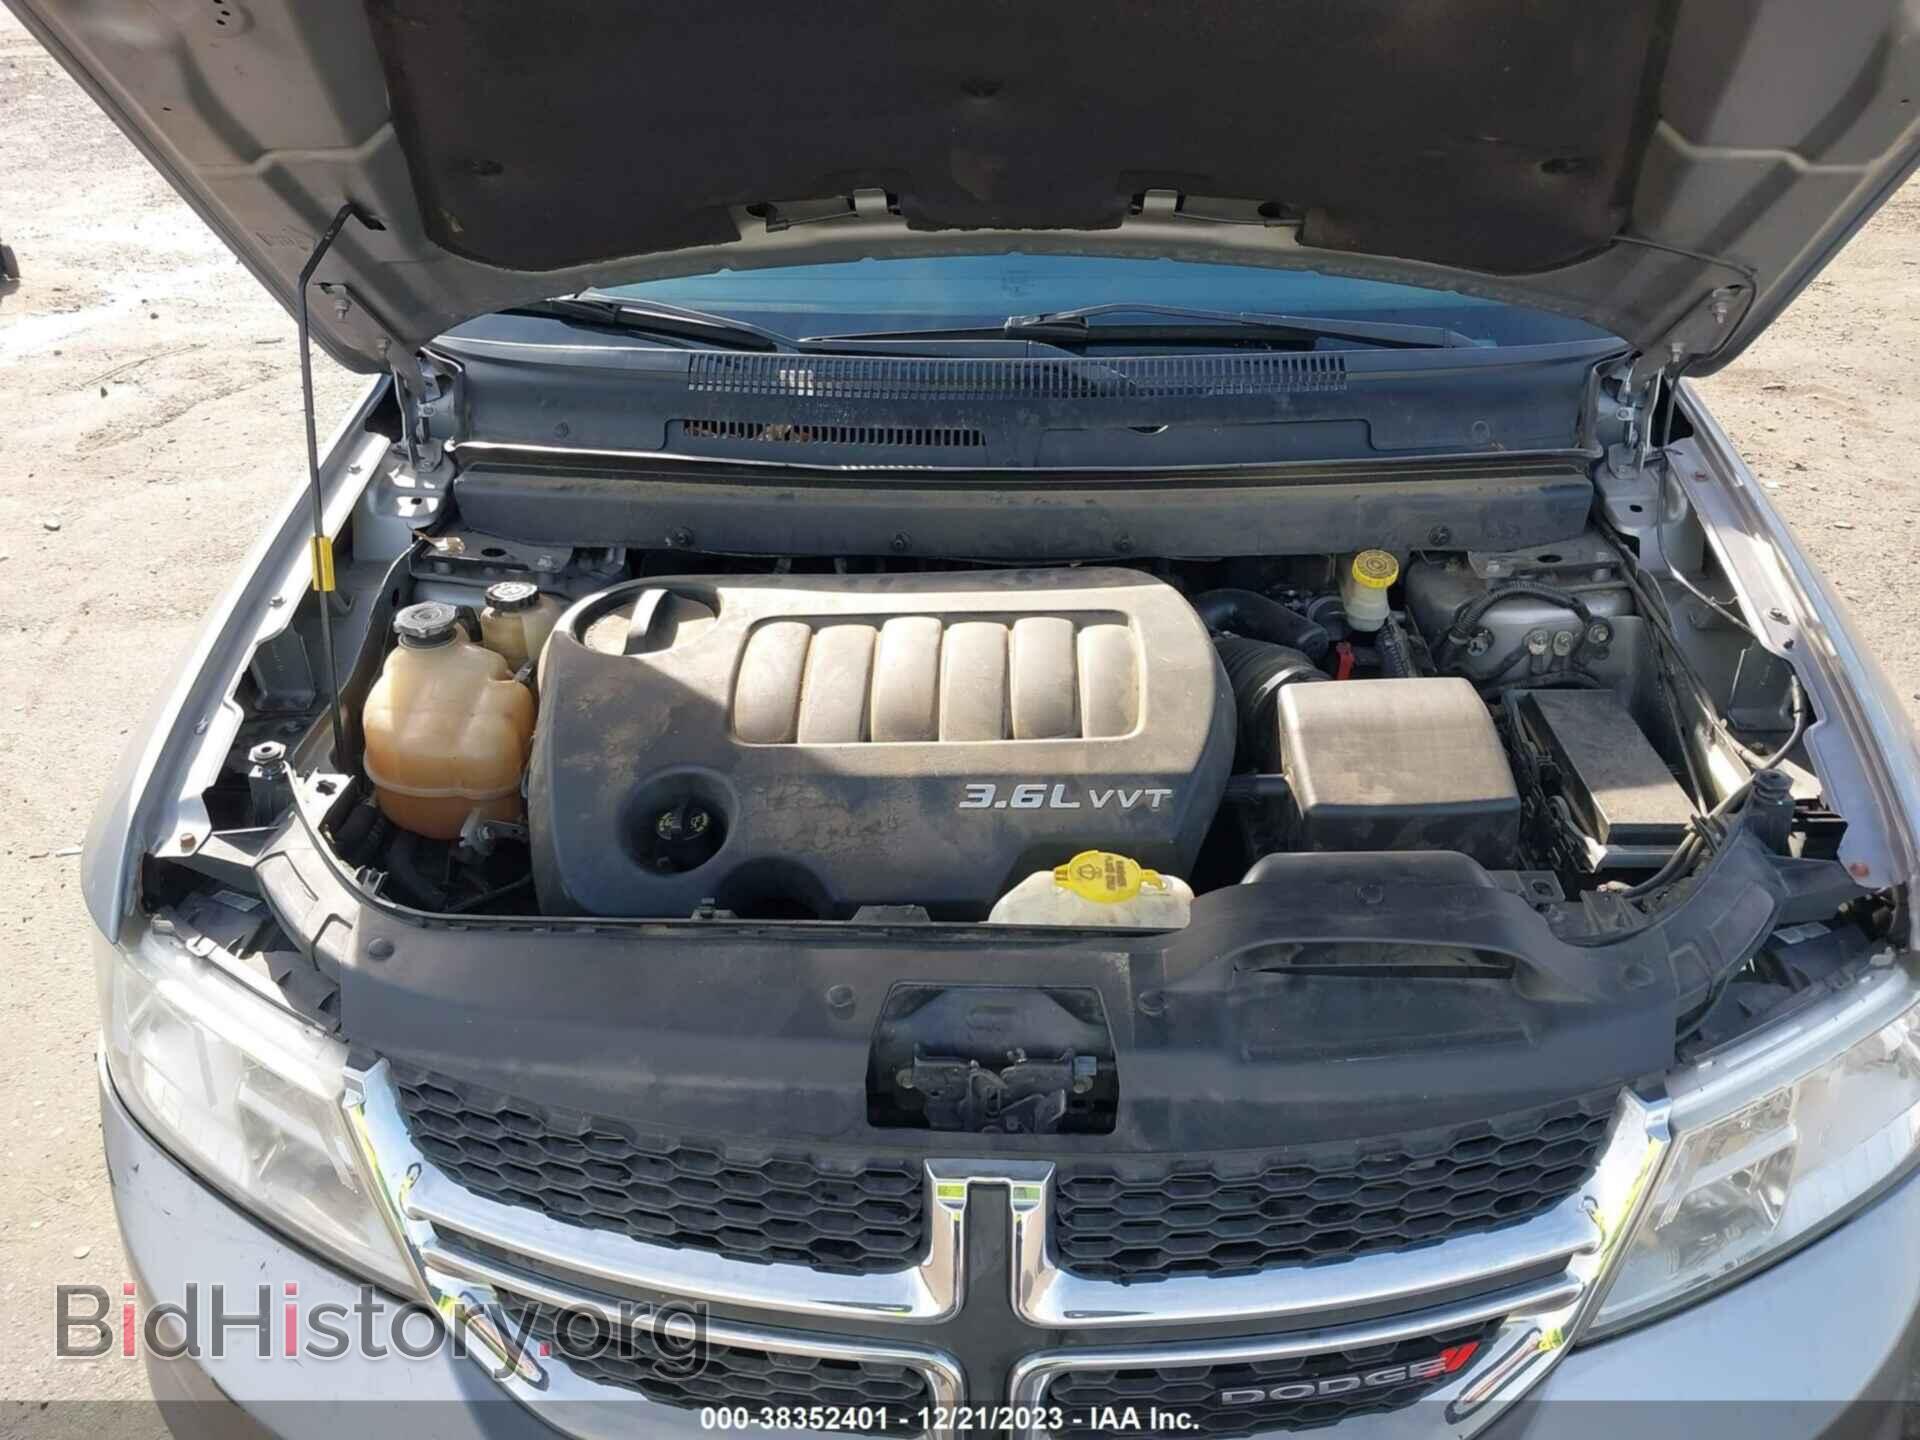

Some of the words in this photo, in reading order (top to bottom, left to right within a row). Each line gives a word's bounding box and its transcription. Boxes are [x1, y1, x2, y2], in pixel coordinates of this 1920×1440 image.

[959, 783, 1081, 809] 3.6L
[1088, 788, 1173, 809] VVT
[1221, 1356, 1448, 1404] DODGE
